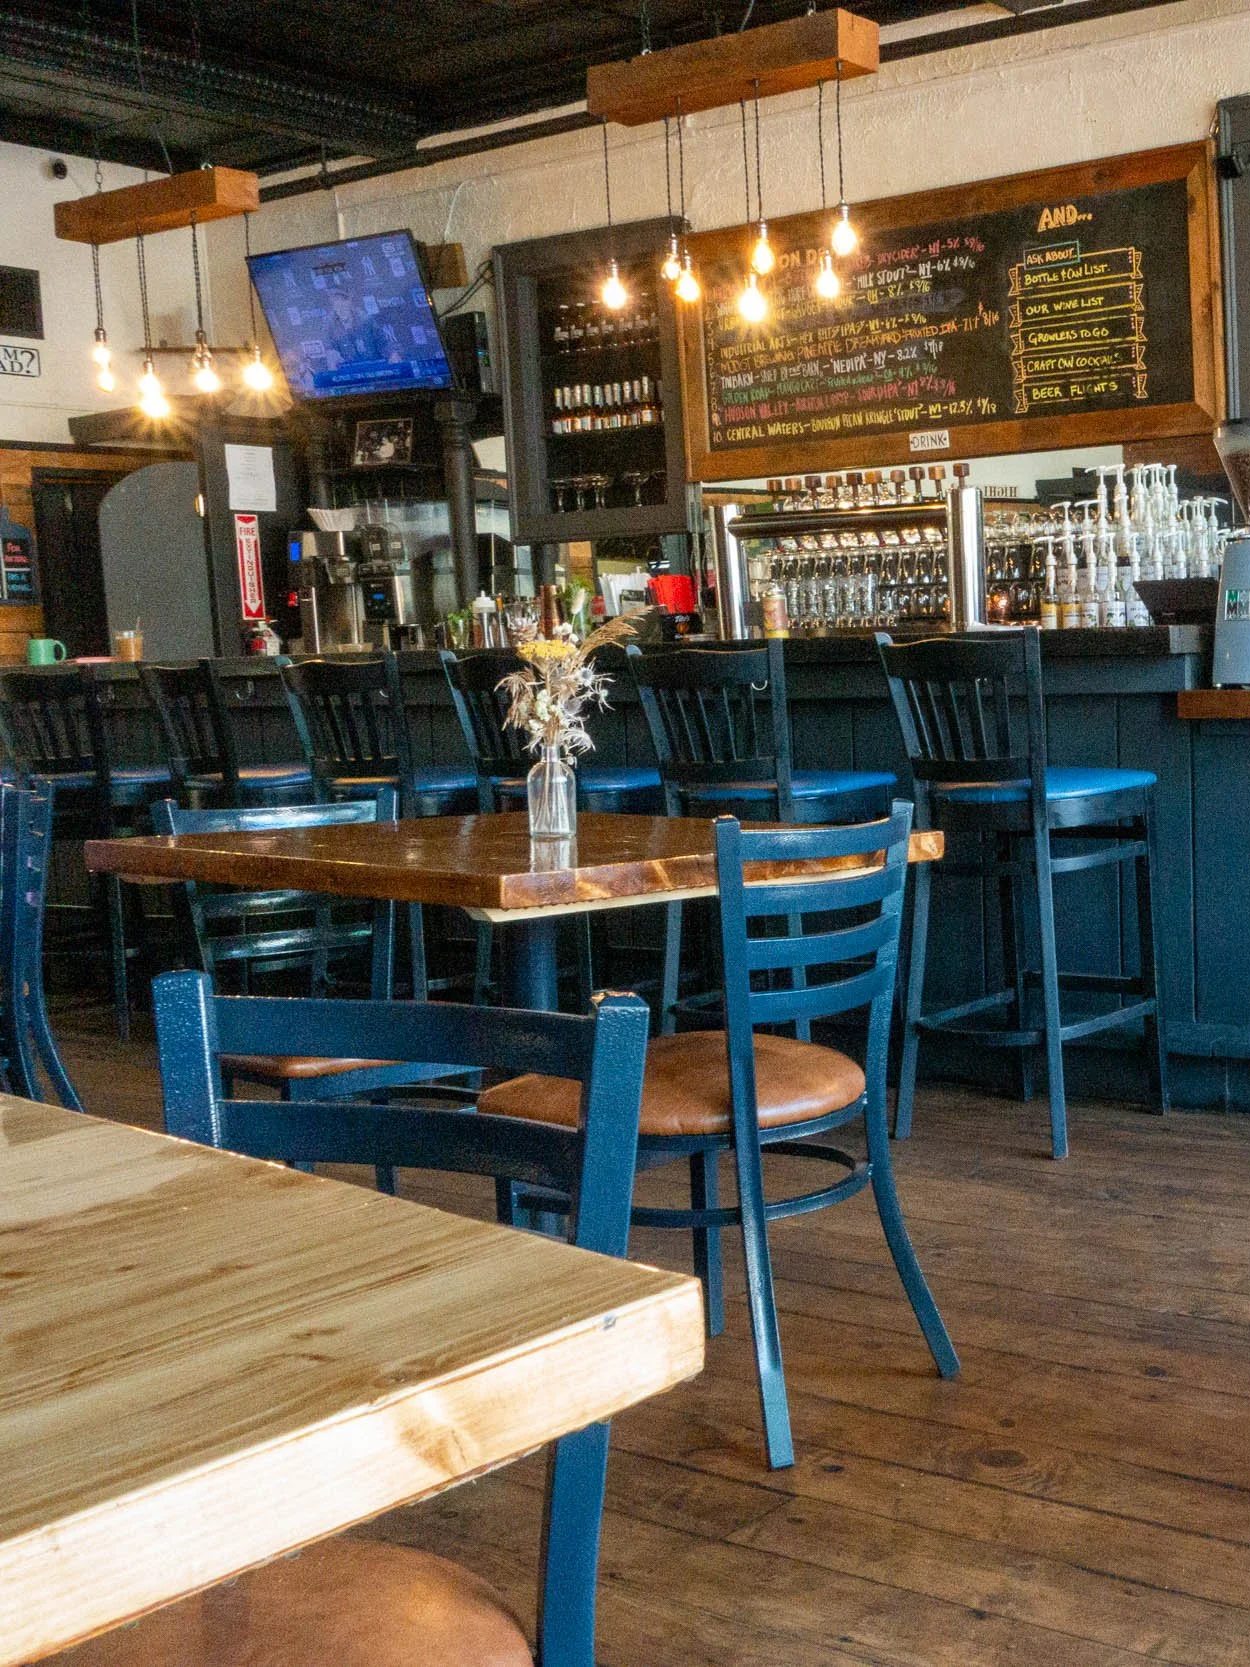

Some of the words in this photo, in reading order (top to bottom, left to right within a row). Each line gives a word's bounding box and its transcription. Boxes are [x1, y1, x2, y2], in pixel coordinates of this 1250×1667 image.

[1026, 254, 1043, 265] ASK
[1024, 271, 1059, 286] BOTTLE
[1026, 304, 1049, 316] OUR
[1053, 299, 1079, 312] WINE
[1081, 296, 1104, 307] LIST
[1028, 329, 1078, 346] GROWLERS
[1079, 329, 1091, 339] TO
[1092, 328, 1109, 338] GO
[1027, 359, 1057, 373] CRAFT
[1032, 386, 1062, 400] BEER
[726, 424, 766, 442] CENTRAL
[767, 420, 805, 437] WATERS
[913, 434, 945, 449] DRINK
[239, 527, 256, 537] FIRE
